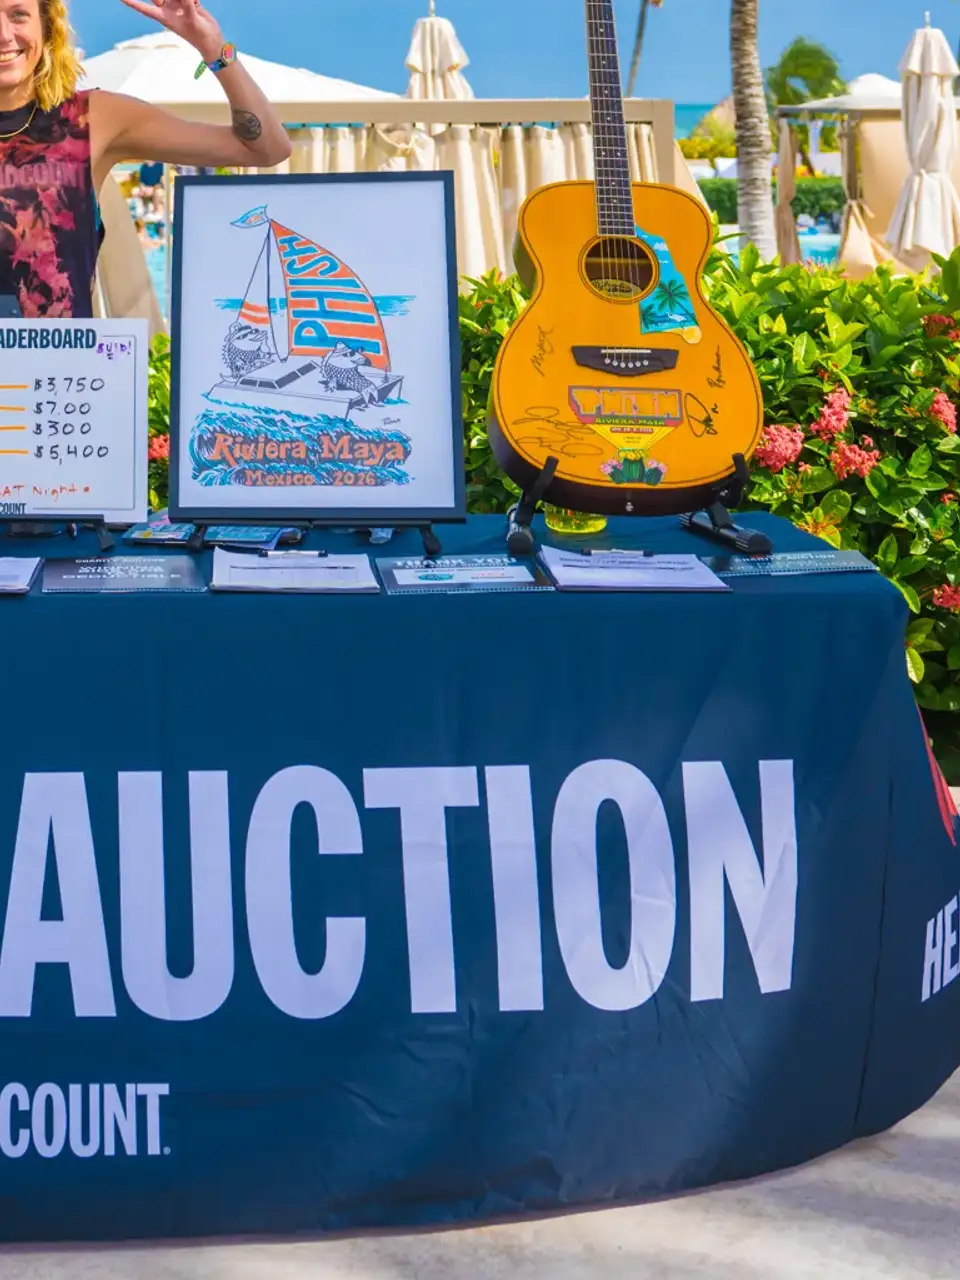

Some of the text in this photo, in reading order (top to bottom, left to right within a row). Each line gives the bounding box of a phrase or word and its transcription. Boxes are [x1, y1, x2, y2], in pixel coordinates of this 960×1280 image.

[279, 235, 382, 356] PHISH
[34, 377, 105, 396] $3,750
[33, 420, 91, 436] $300
[34, 444, 109, 466] $5,400
[206, 433, 404, 468] Riviera Maya
[333, 470, 376, 486] 2026
